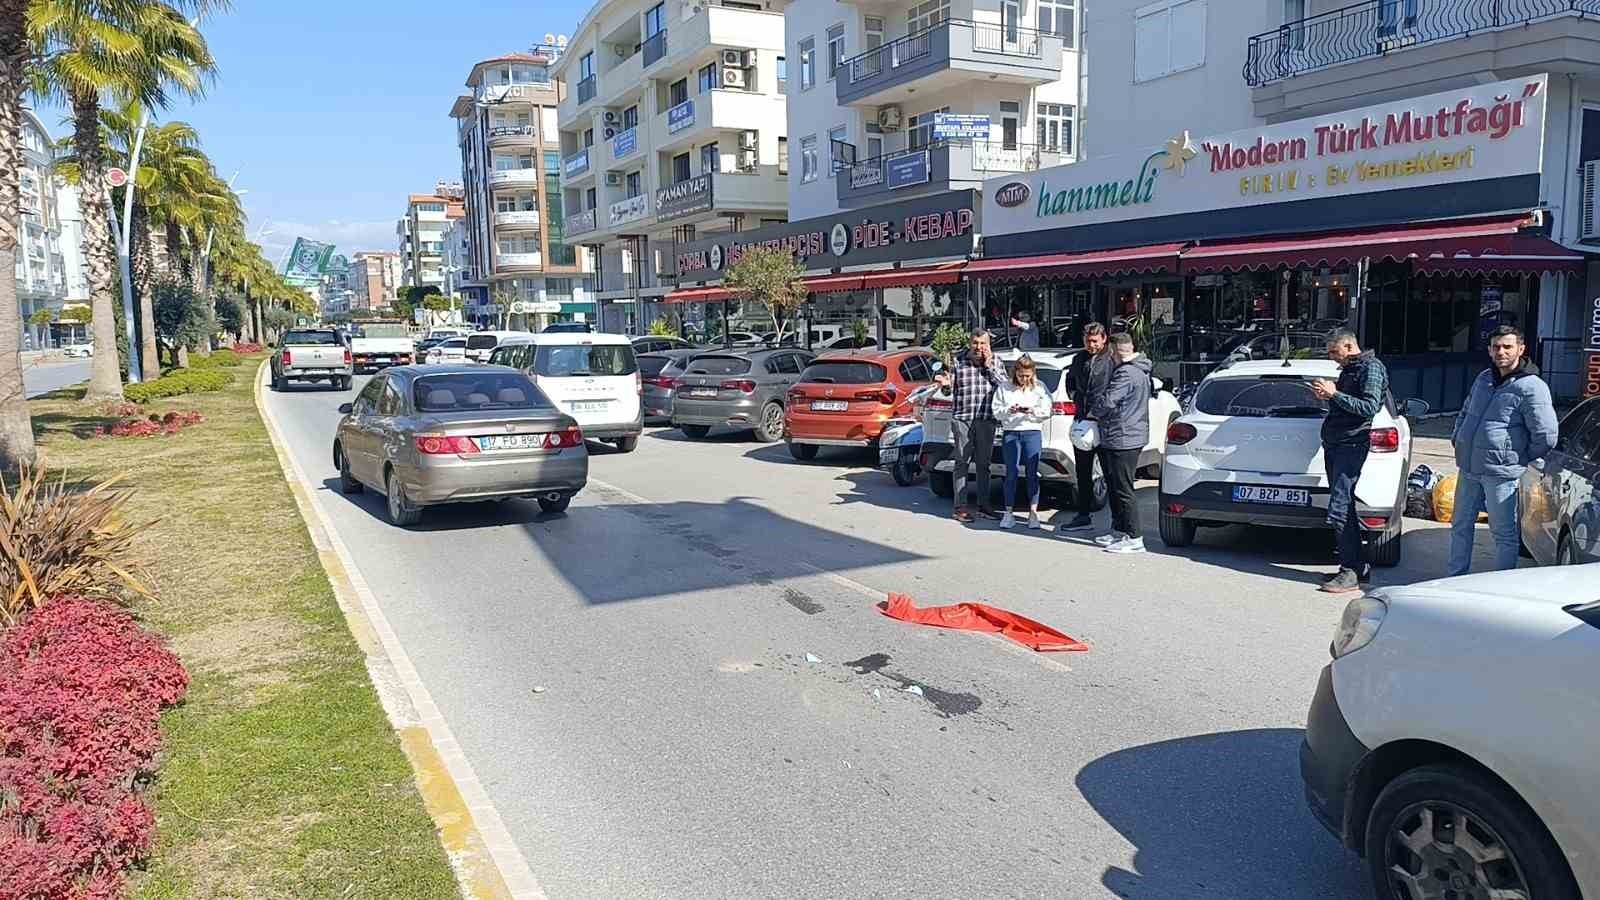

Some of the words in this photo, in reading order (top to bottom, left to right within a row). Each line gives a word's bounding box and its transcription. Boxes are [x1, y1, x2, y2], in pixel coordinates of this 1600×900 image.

[1314, 117, 1378, 156] Türk
[1036, 152, 1167, 217] hanımeli
[1327, 164, 1349, 187] Ev
[1356, 146, 1475, 183] Yemekleri
[999, 186, 1024, 203] MTM
[853, 218, 890, 249] PİDE
[904, 208, 973, 243] KEBAP
[1240, 487, 1253, 498] 07
[1260, 488, 1280, 500] BZP
[1286, 489, 1307, 501] 851
